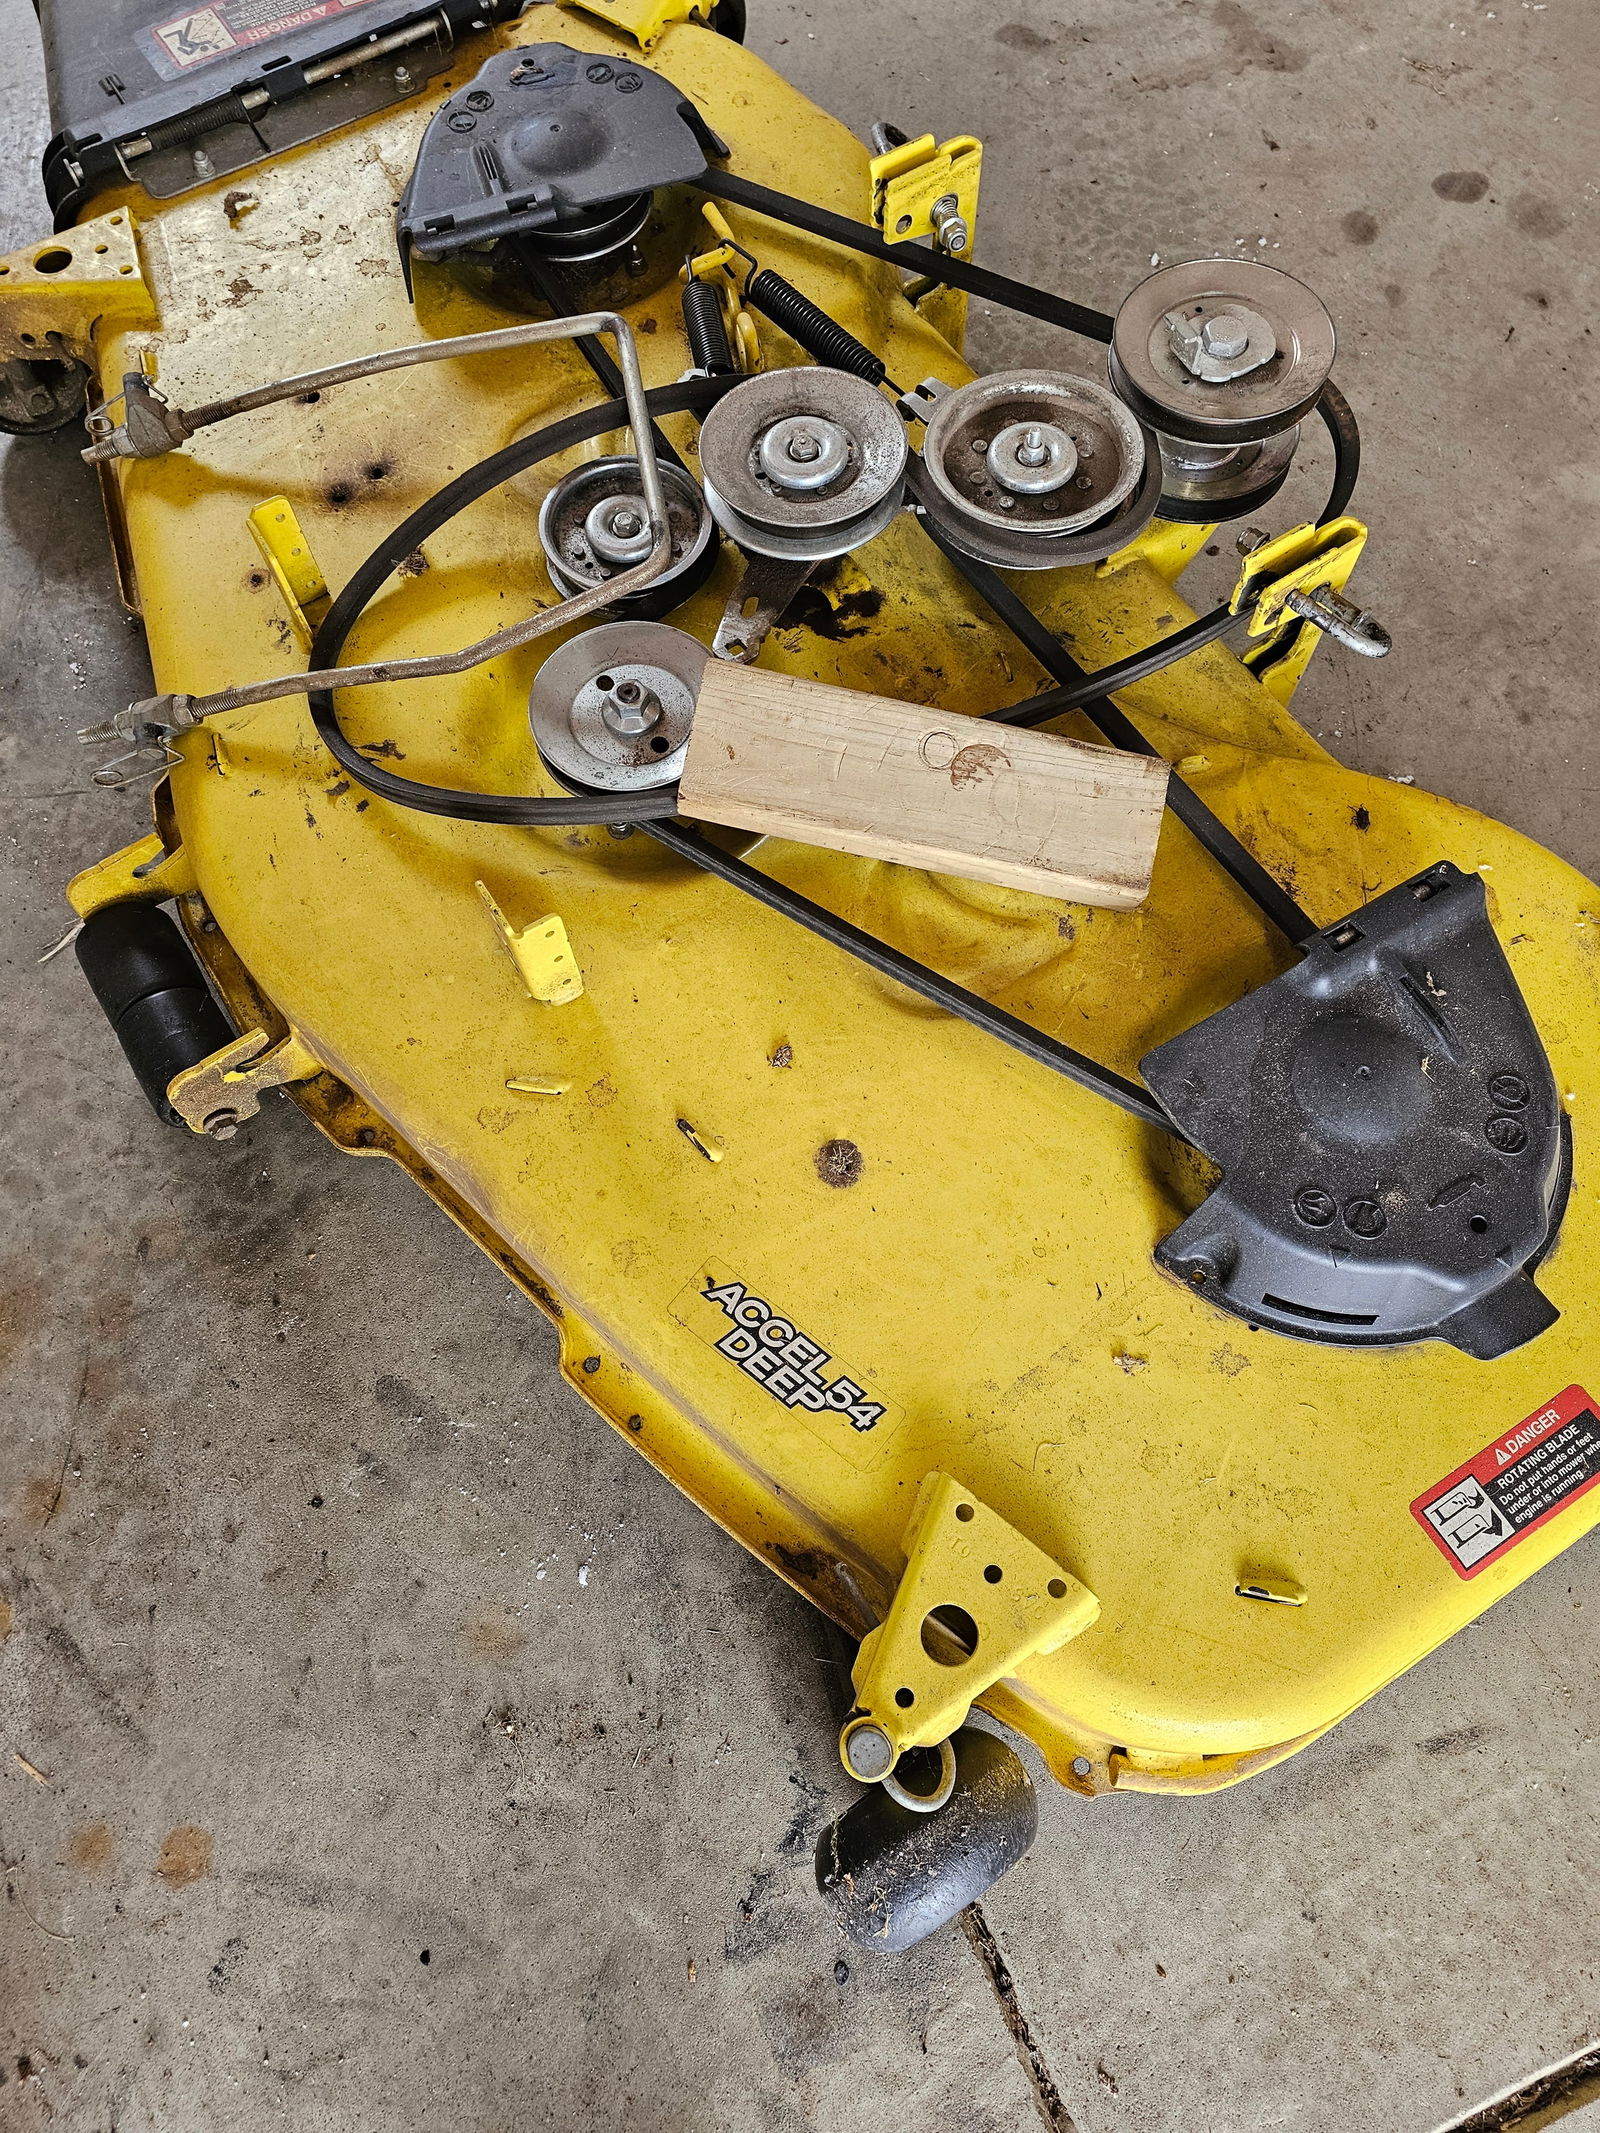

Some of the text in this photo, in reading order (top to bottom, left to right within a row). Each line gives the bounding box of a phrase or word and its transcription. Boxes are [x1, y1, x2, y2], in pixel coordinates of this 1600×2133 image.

[248, 12, 313, 40] DANGER
[701, 1282, 831, 1389] ACCEL
[714, 1326, 887, 1431] DEEP 54
[1497, 1424, 1580, 1490] ROTATING BLADE
[1505, 1408, 1561, 1454] DANGER
[1499, 1432, 1594, 1506] Do not put hands or feet
[1508, 1440, 1600, 1514] under or into mower whe
[1515, 1470, 1585, 1524] engine is running
